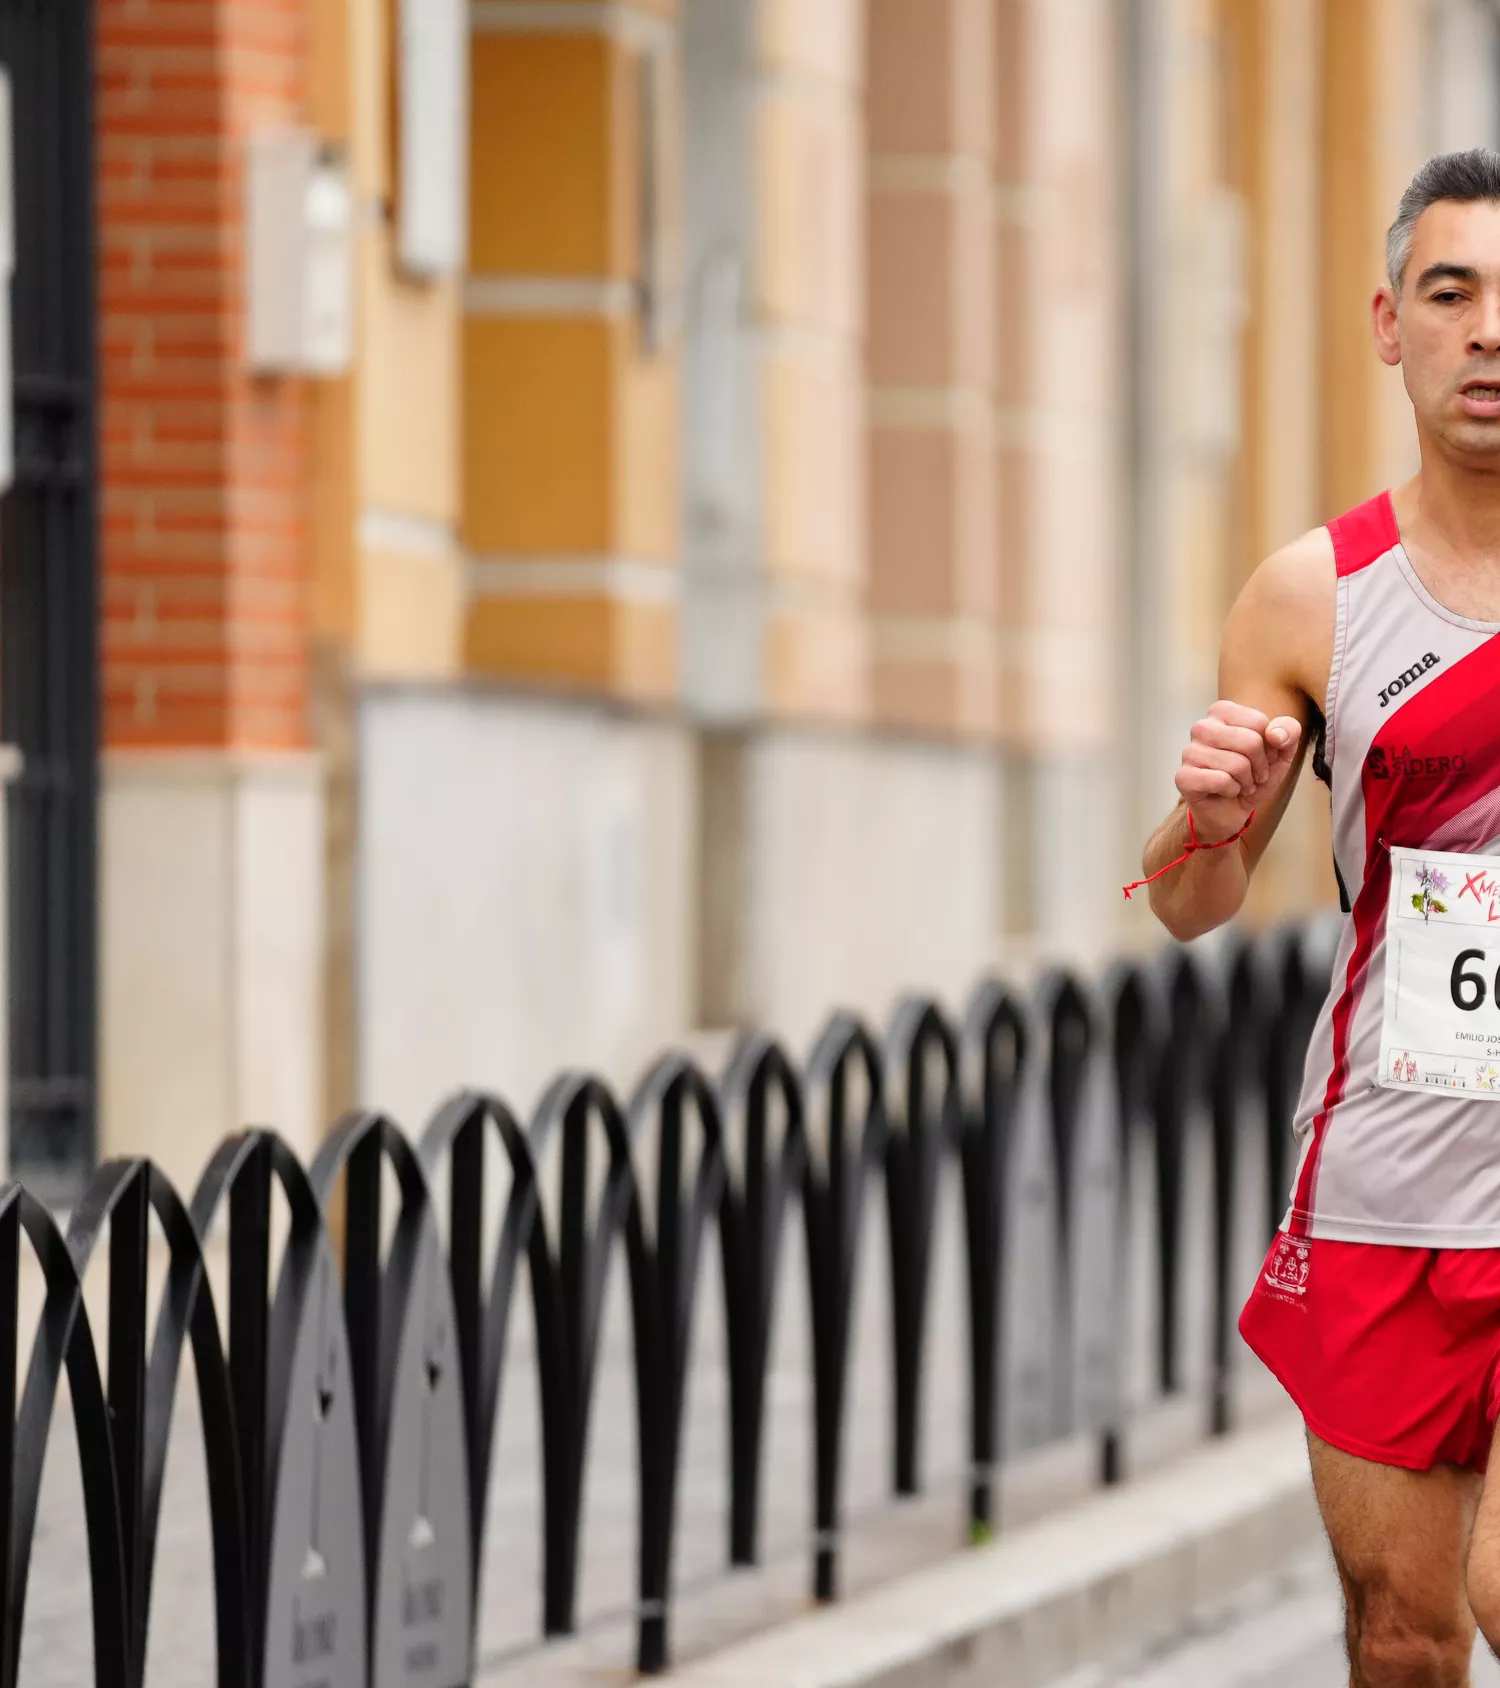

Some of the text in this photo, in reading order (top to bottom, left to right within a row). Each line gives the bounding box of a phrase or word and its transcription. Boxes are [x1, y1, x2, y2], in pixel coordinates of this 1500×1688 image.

[1390, 745, 1412, 760] LA
[1392, 755, 1466, 777] SIDERO
[1458, 870, 1487, 904] X
[1455, 1031, 1485, 1043] EMILIO
